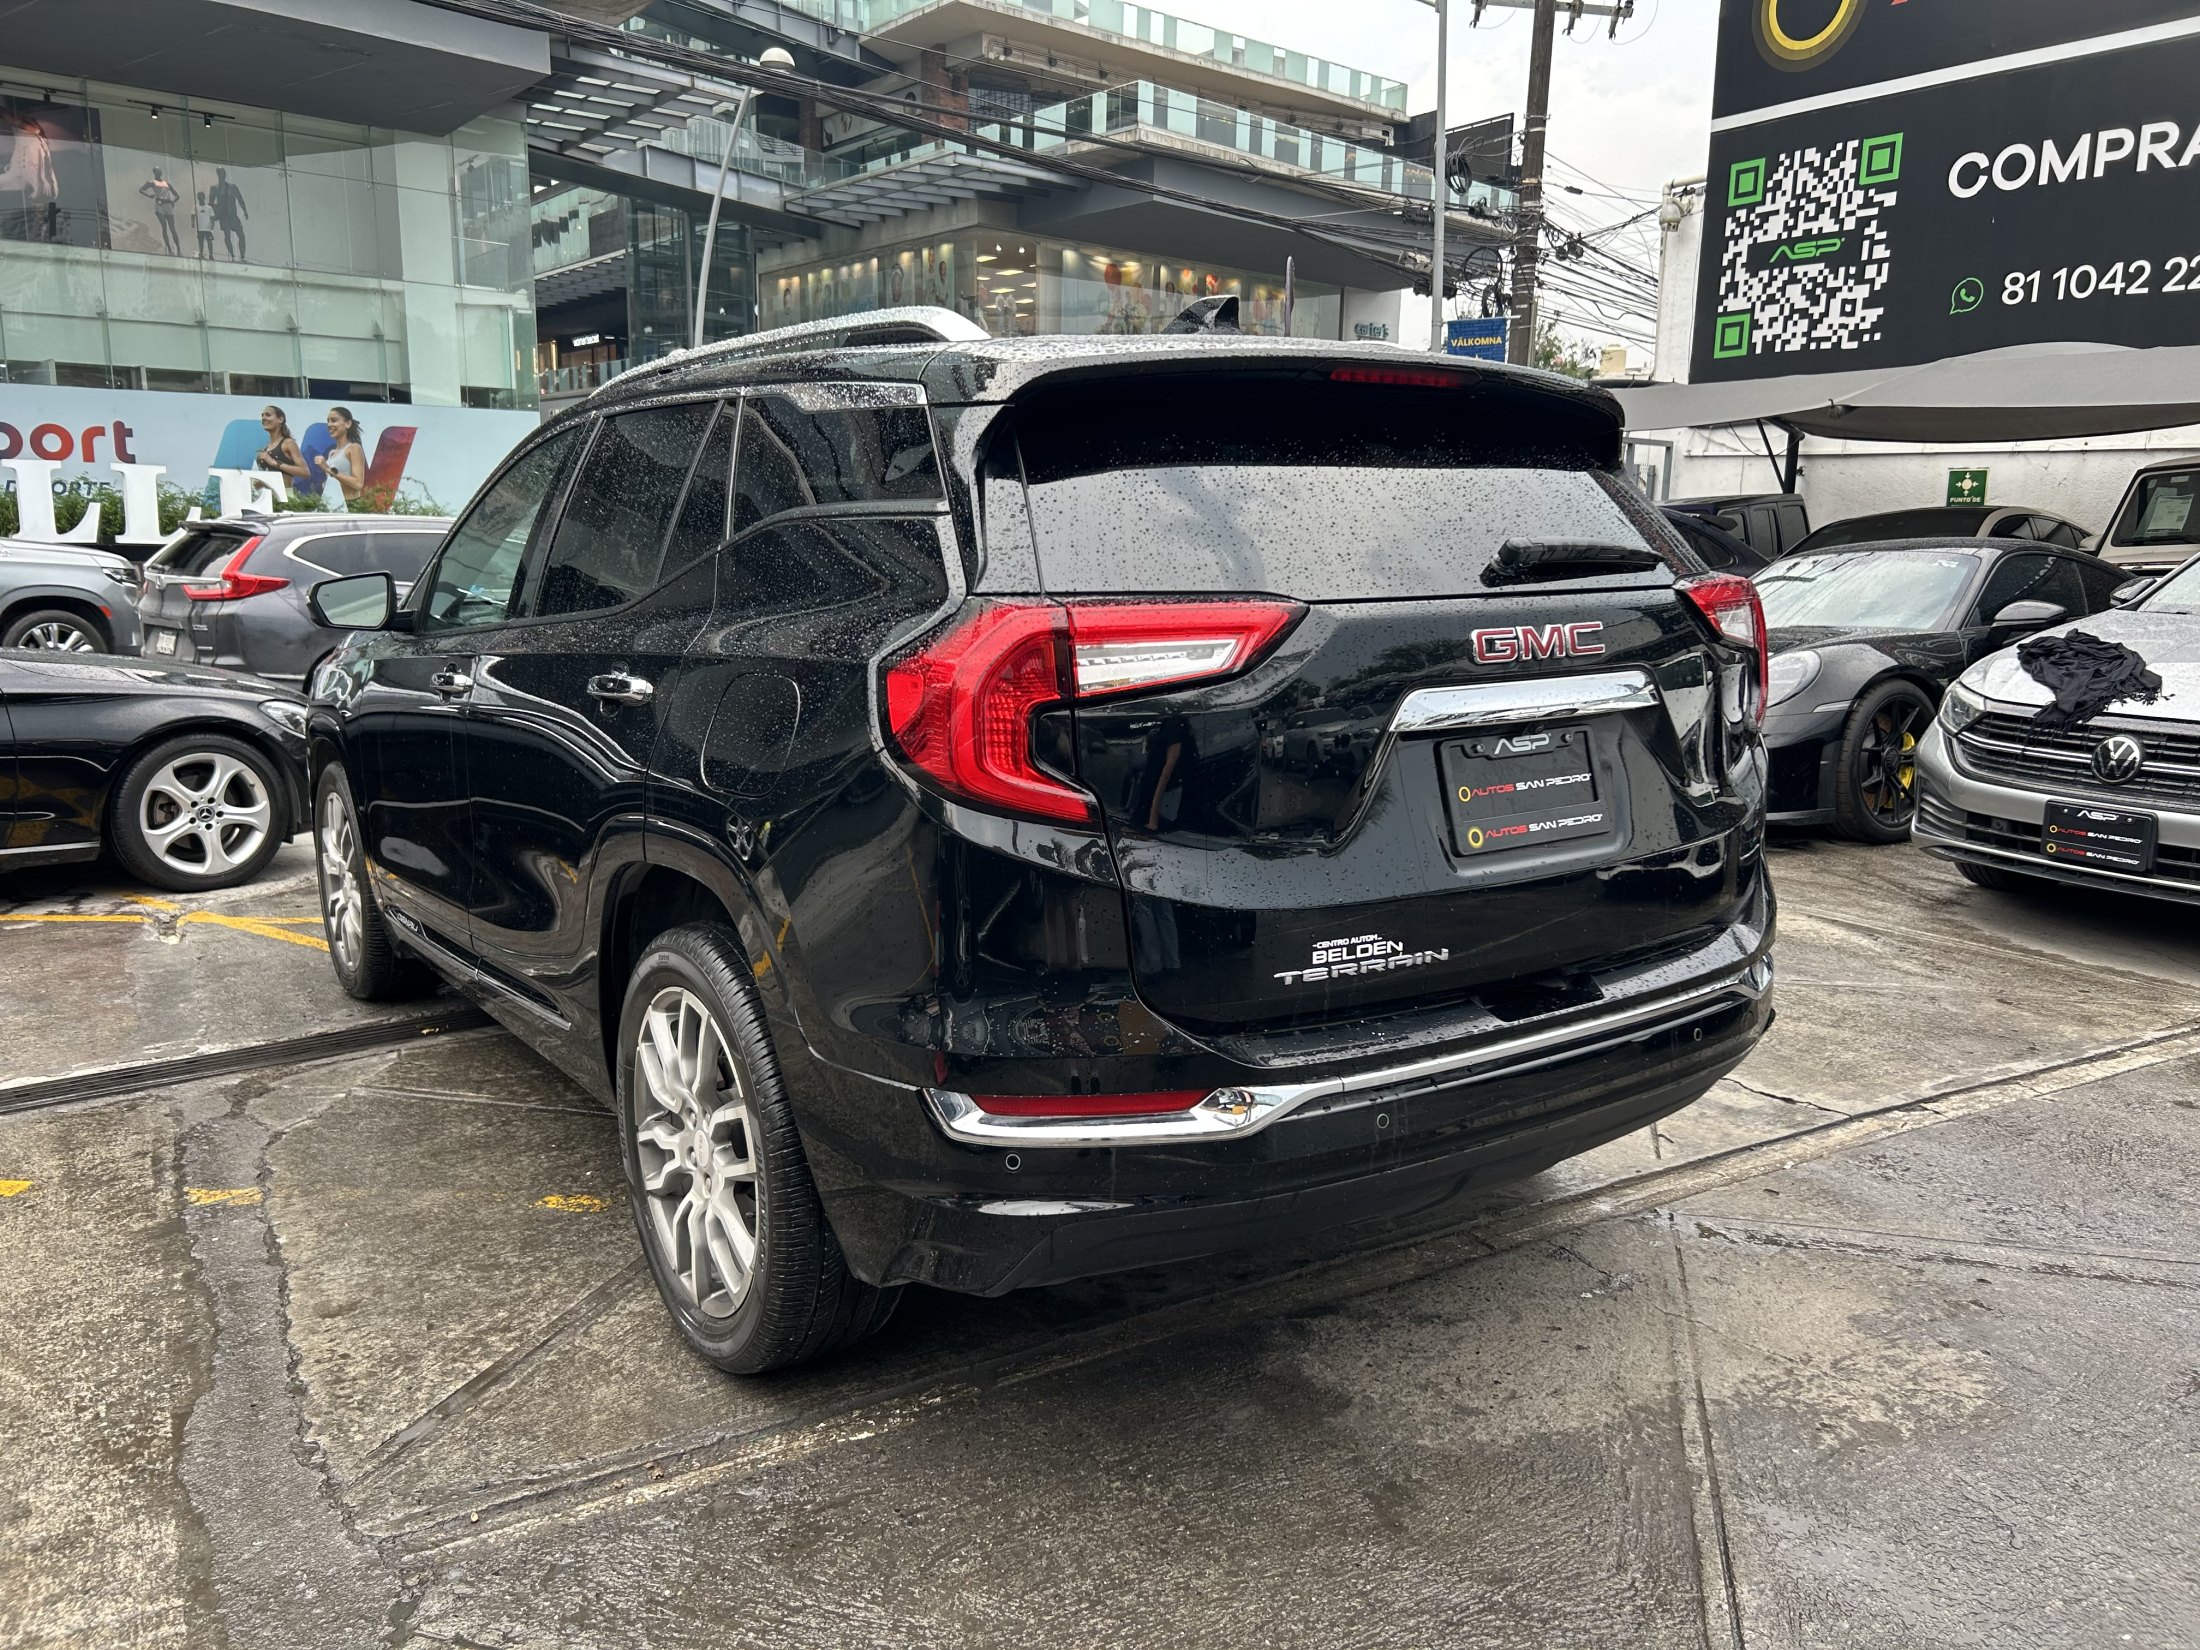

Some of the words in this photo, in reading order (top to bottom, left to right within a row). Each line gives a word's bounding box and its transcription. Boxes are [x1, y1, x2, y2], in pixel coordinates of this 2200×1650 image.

[2001, 270, 2041, 305] 81
[2052, 259, 2151, 300] 1042
[1451, 336, 1502, 347] VÄLKOMNA
[1471, 621, 1605, 664] GMC
[1494, 733, 1550, 754] ASP
[1471, 783, 1515, 797] AUTOS
[1515, 779, 1545, 791] SAN
[1546, 773, 1590, 787] PEDRO
[1485, 824, 1528, 839] AUTOS
[1528, 820, 1557, 832] SAN
[1558, 814, 1601, 828] PEDRO
[2057, 827, 2087, 836] AUTOS
[2108, 835, 2141, 844] PEDRO
[2057, 846, 2086, 856] AUTOS
[2086, 851, 2106, 860] SAN
[2106, 855, 2139, 865] PEDRO
[1312, 940, 1403, 965] BELDEN
[1273, 948, 1449, 985] TERRAIN
